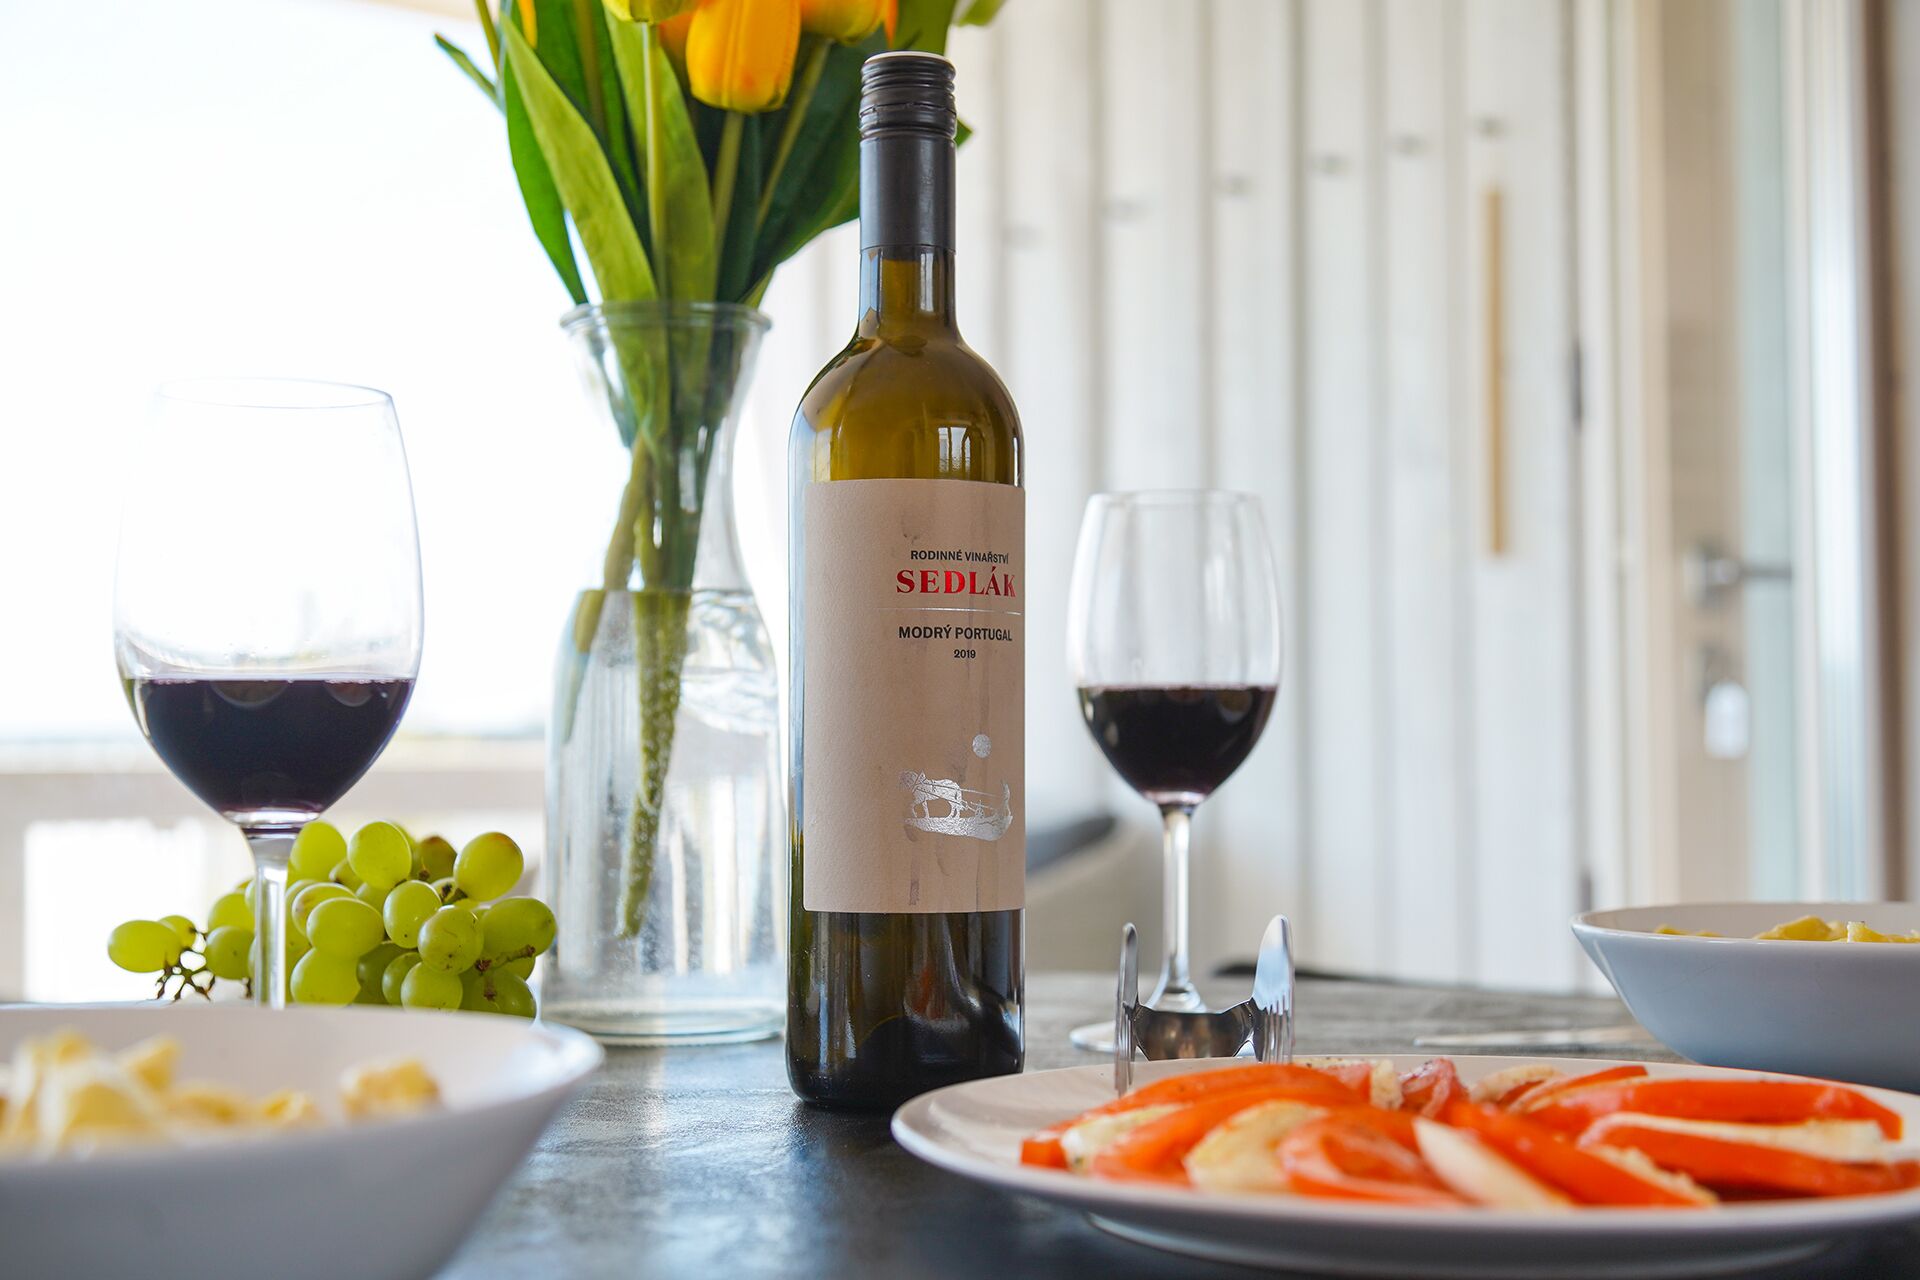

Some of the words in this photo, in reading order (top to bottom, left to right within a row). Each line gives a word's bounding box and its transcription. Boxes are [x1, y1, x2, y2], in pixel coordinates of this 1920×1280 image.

[910, 549, 962, 561] RODINNÉ
[965, 551, 1009, 564] VINAŘSTVÍ
[896, 566, 1016, 597] SEDLÁK
[899, 624, 952, 639] MODRÝ
[955, 627, 1012, 641] PORTUGAL
[954, 649, 976, 659] 2019
